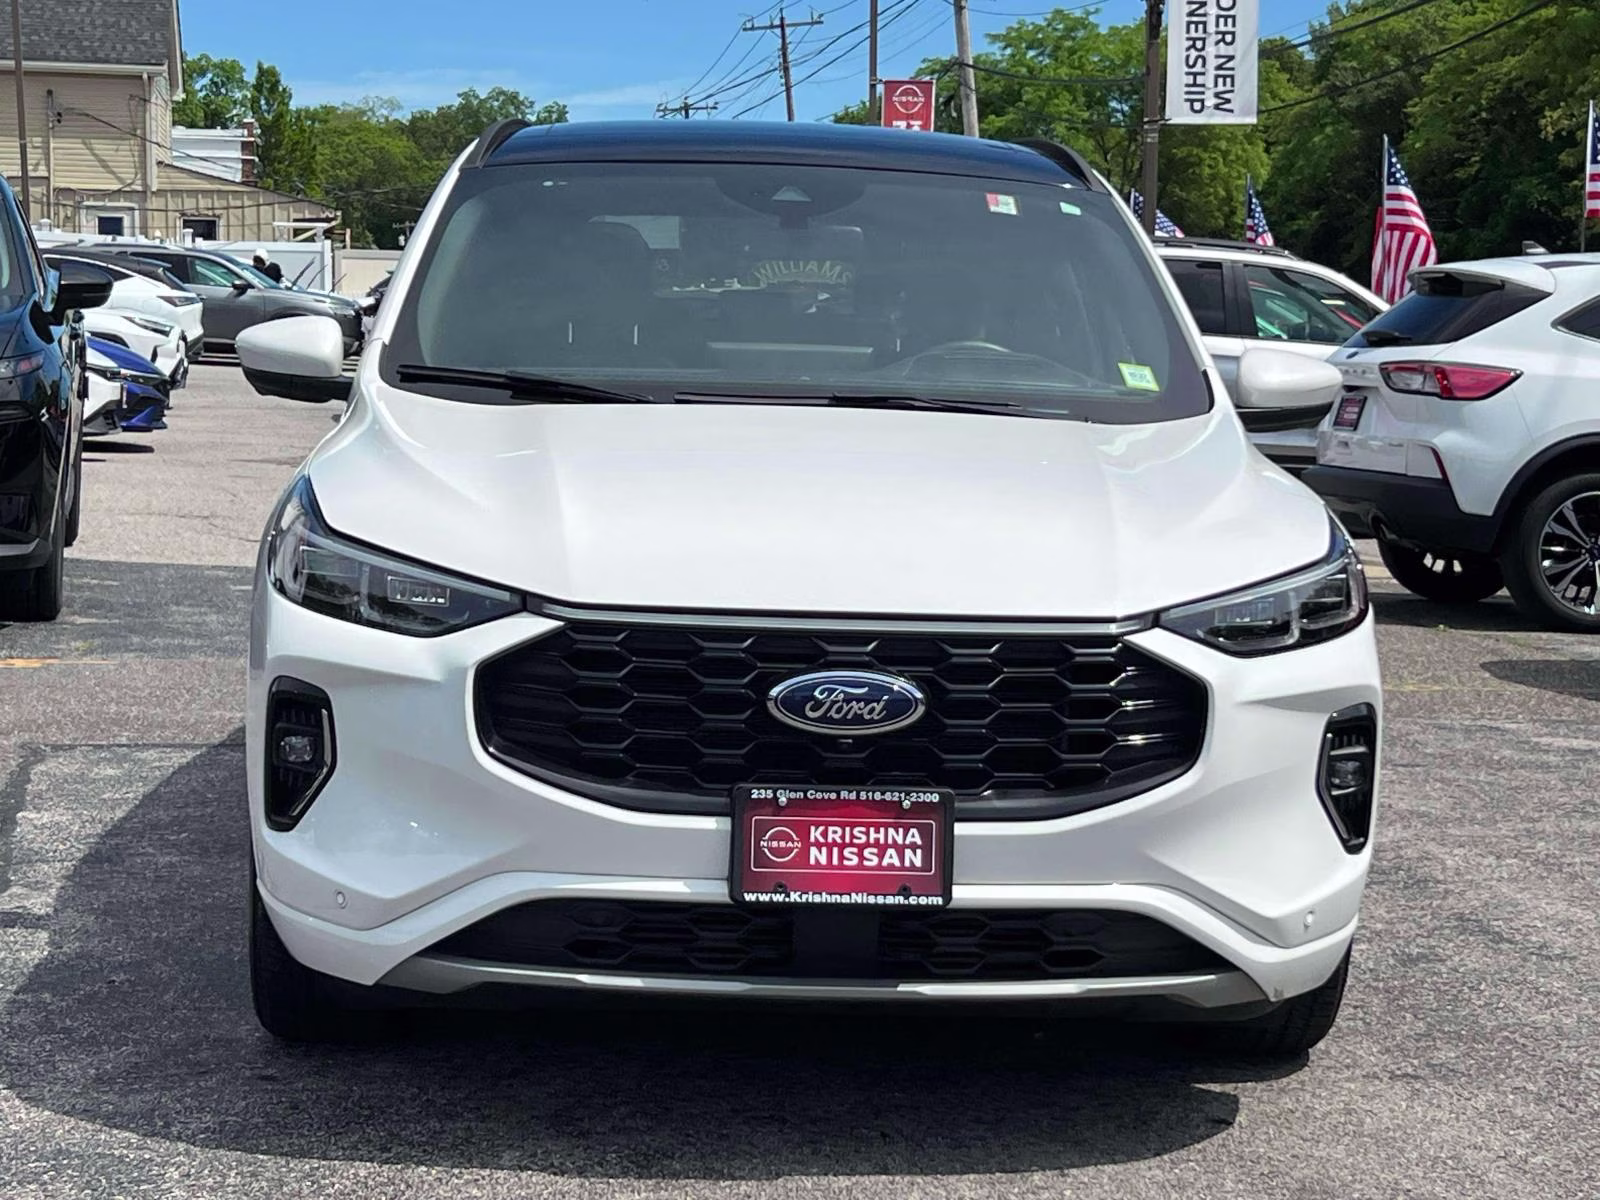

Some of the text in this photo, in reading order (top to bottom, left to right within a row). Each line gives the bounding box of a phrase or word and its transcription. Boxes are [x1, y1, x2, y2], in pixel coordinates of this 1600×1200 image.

[1184, 0, 1208, 114] NERSHIP
[1213, 54, 1236, 114] NEW
[805, 684, 889, 720] Ford
[751, 789, 940, 802] 235 Glen Cove Rd 516-621-2300
[760, 840, 802, 848] NISSAN
[809, 825, 922, 845] KRISHNA
[809, 846, 922, 867] NISSAN
[743, 891, 943, 905] www.KrishnaNissan.com
